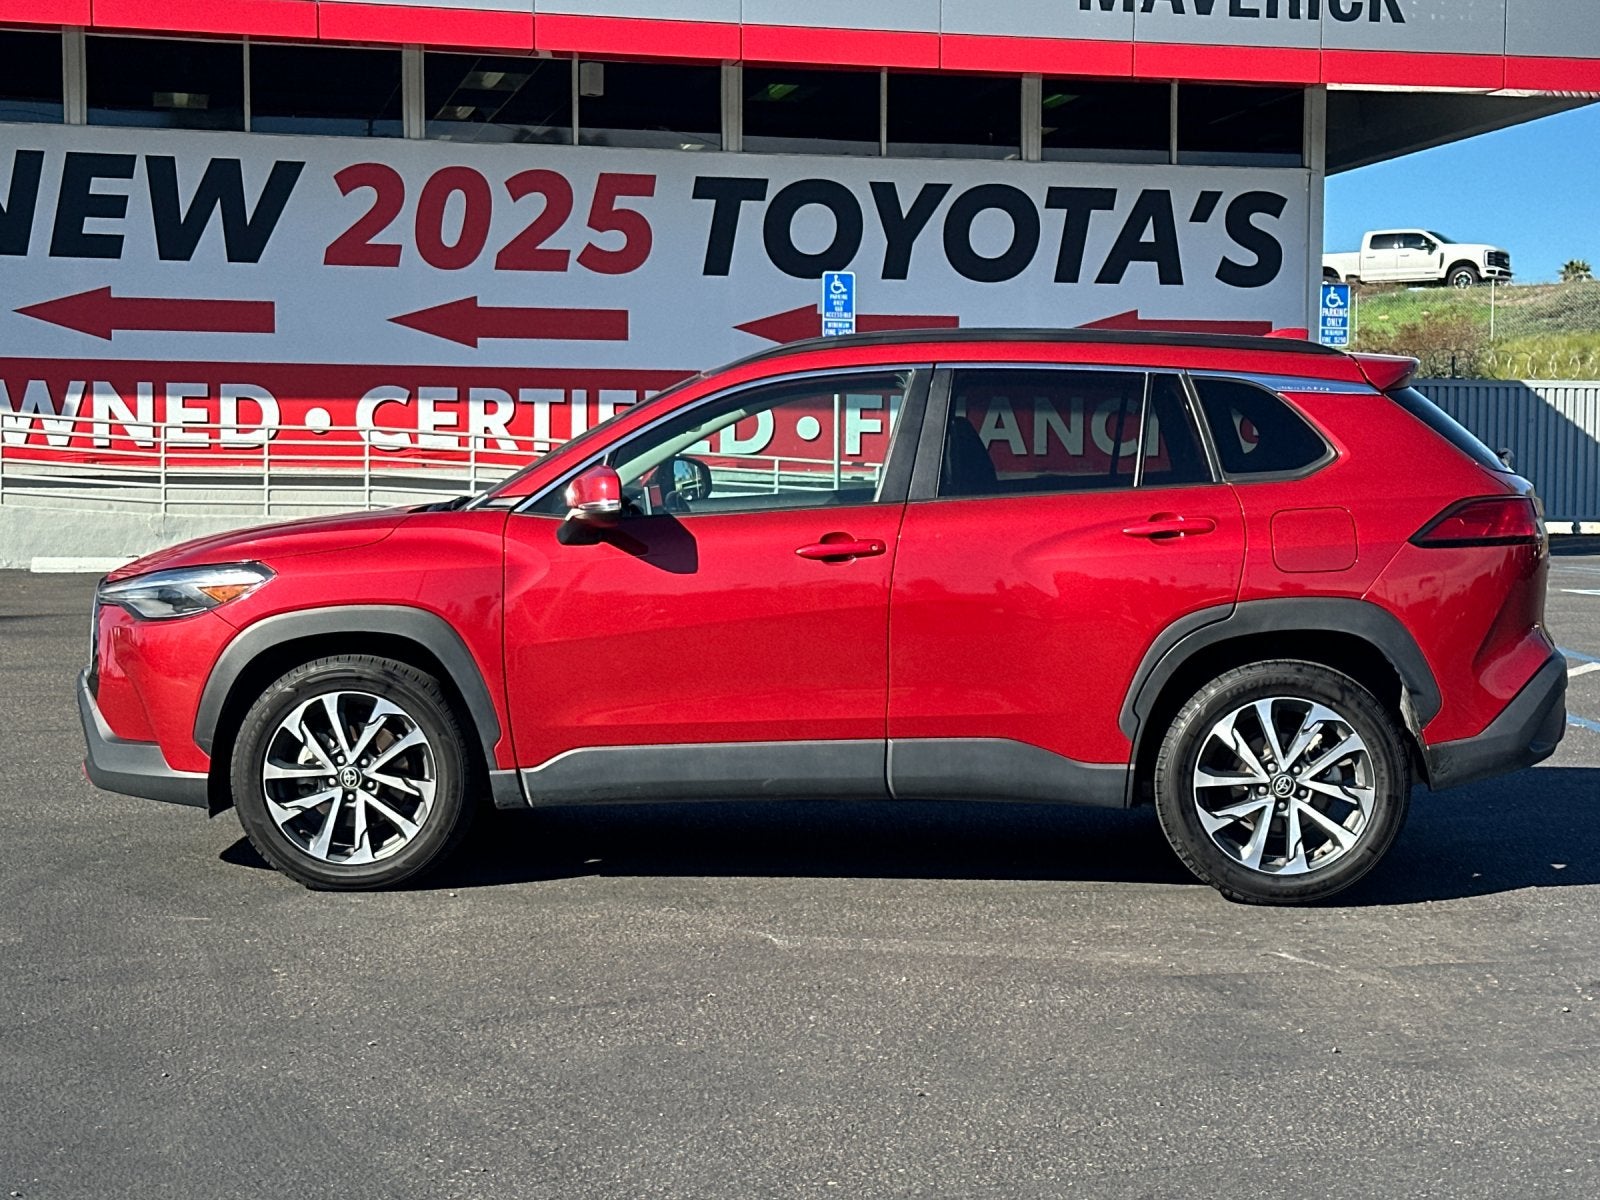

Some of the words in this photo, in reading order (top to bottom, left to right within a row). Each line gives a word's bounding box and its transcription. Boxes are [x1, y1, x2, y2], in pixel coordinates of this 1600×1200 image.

[323, 163, 656, 275] 2025
[692, 177, 1288, 288] TOYOTA'S
[1322, 308, 1348, 317] PARKING
[1327, 318, 1343, 326] ONLY
